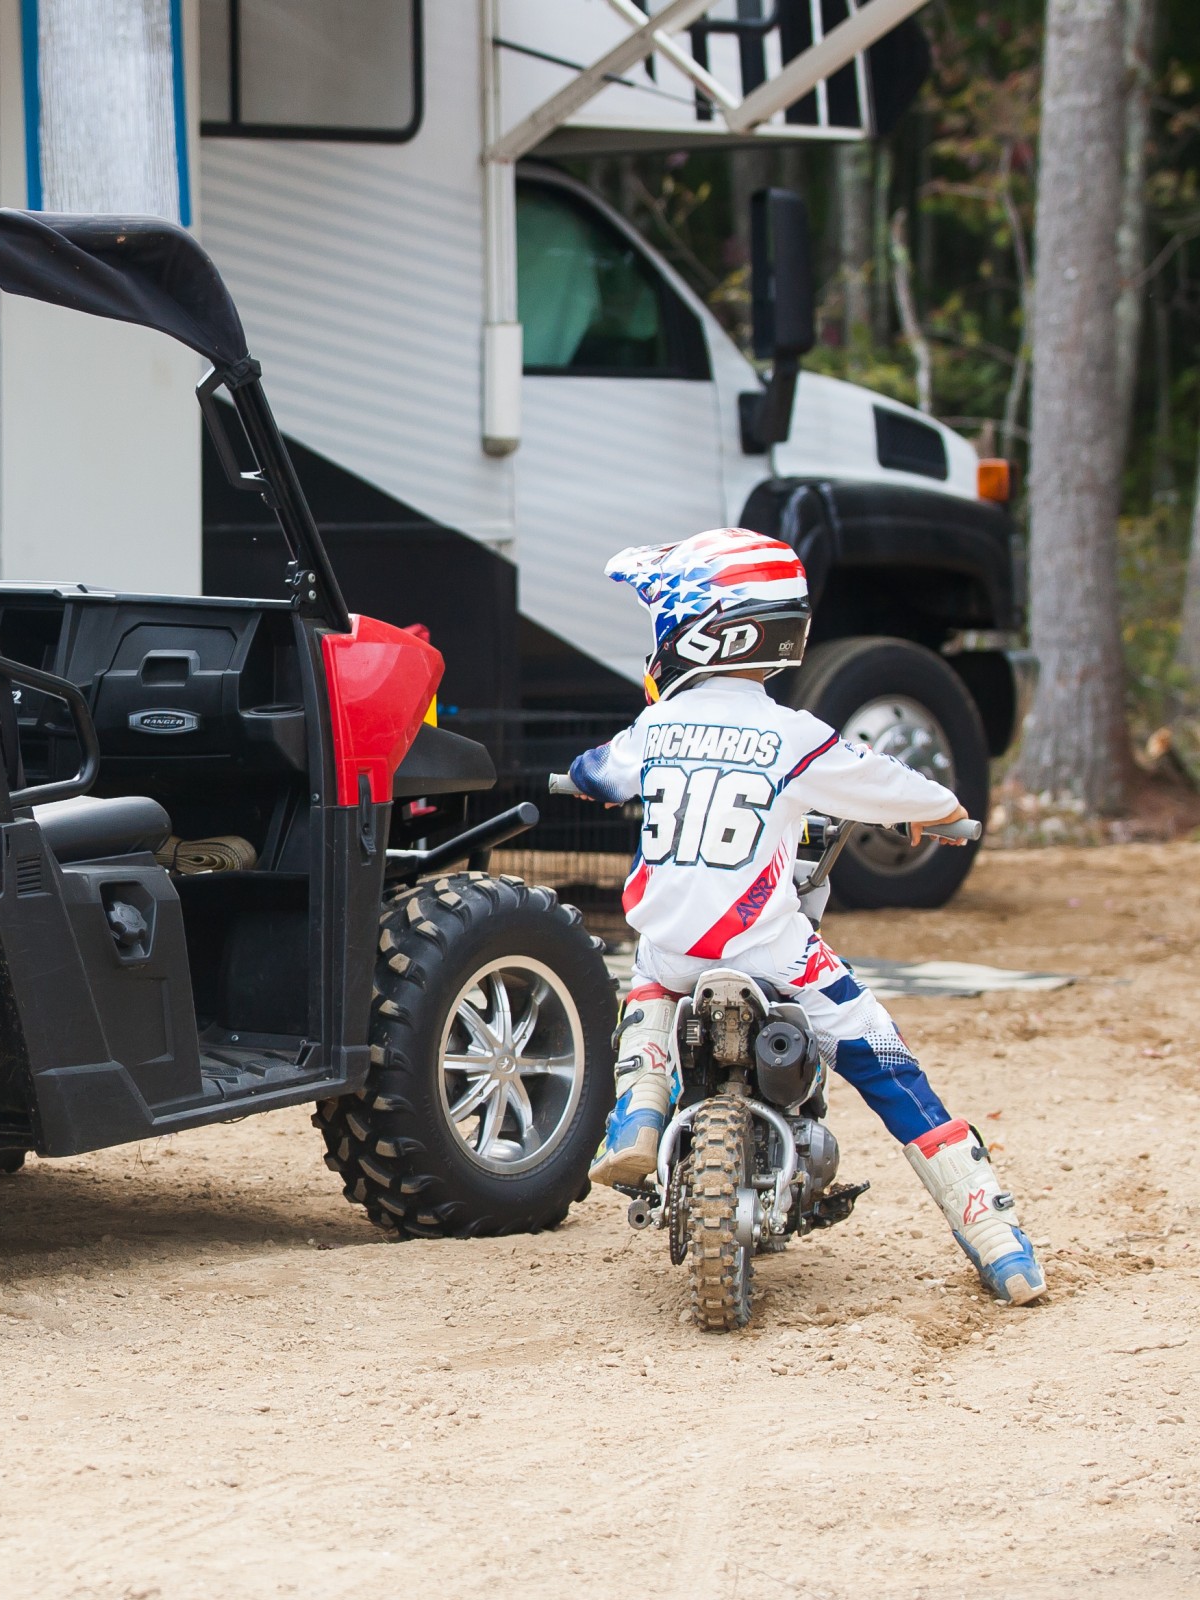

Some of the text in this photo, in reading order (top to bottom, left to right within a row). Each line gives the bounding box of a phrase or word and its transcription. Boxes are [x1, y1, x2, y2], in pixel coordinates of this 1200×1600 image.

[674, 607, 759, 666] 6D
[643, 723, 783, 768] RICHARDS
[641, 766, 776, 870] 316
[736, 876, 776, 928] ANSR
